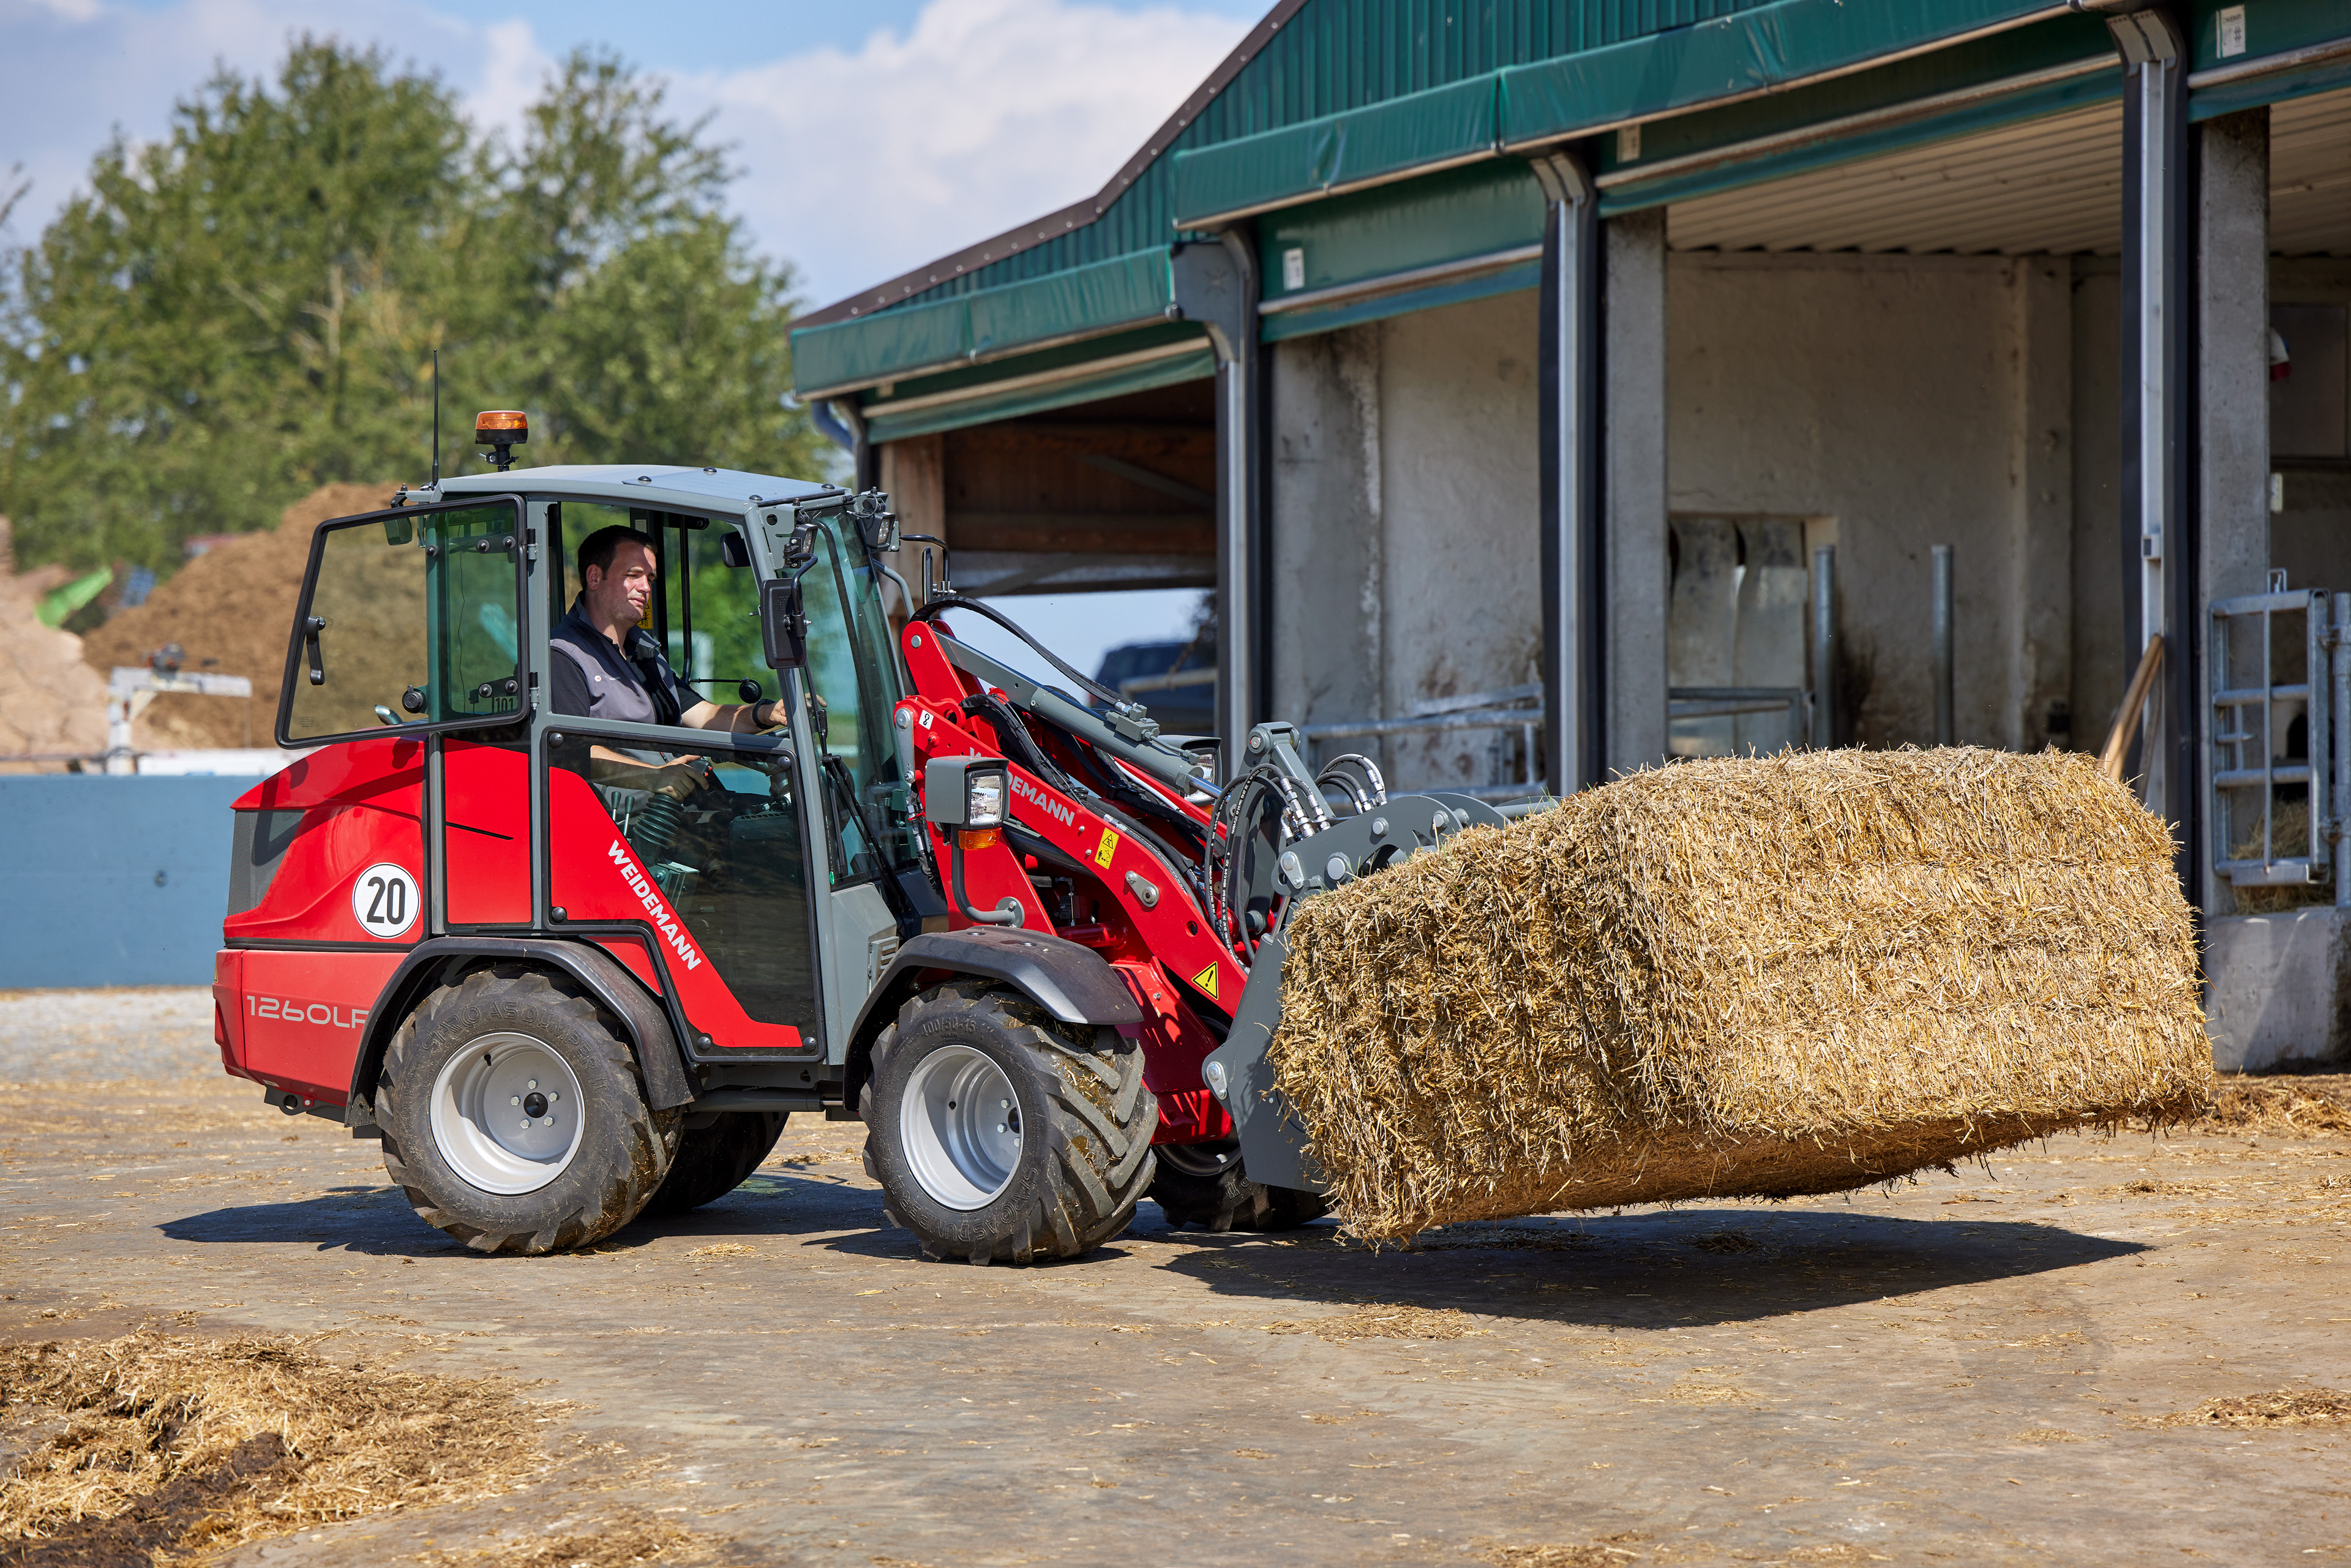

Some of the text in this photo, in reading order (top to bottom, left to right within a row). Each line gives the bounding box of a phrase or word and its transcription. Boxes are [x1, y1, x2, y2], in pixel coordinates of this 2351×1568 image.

[970, 747, 1075, 827] DEMANN
[366, 876, 406, 925] 20
[608, 839, 702, 970] WEIDEMANN
[487, 1001, 519, 1020] AS
[522, 1004, 601, 1074] DUMPER
[921, 1016, 977, 1037] 400/50-15
[899, 1191, 970, 1242] DUMPER
[973, 1215, 997, 1241] AS
